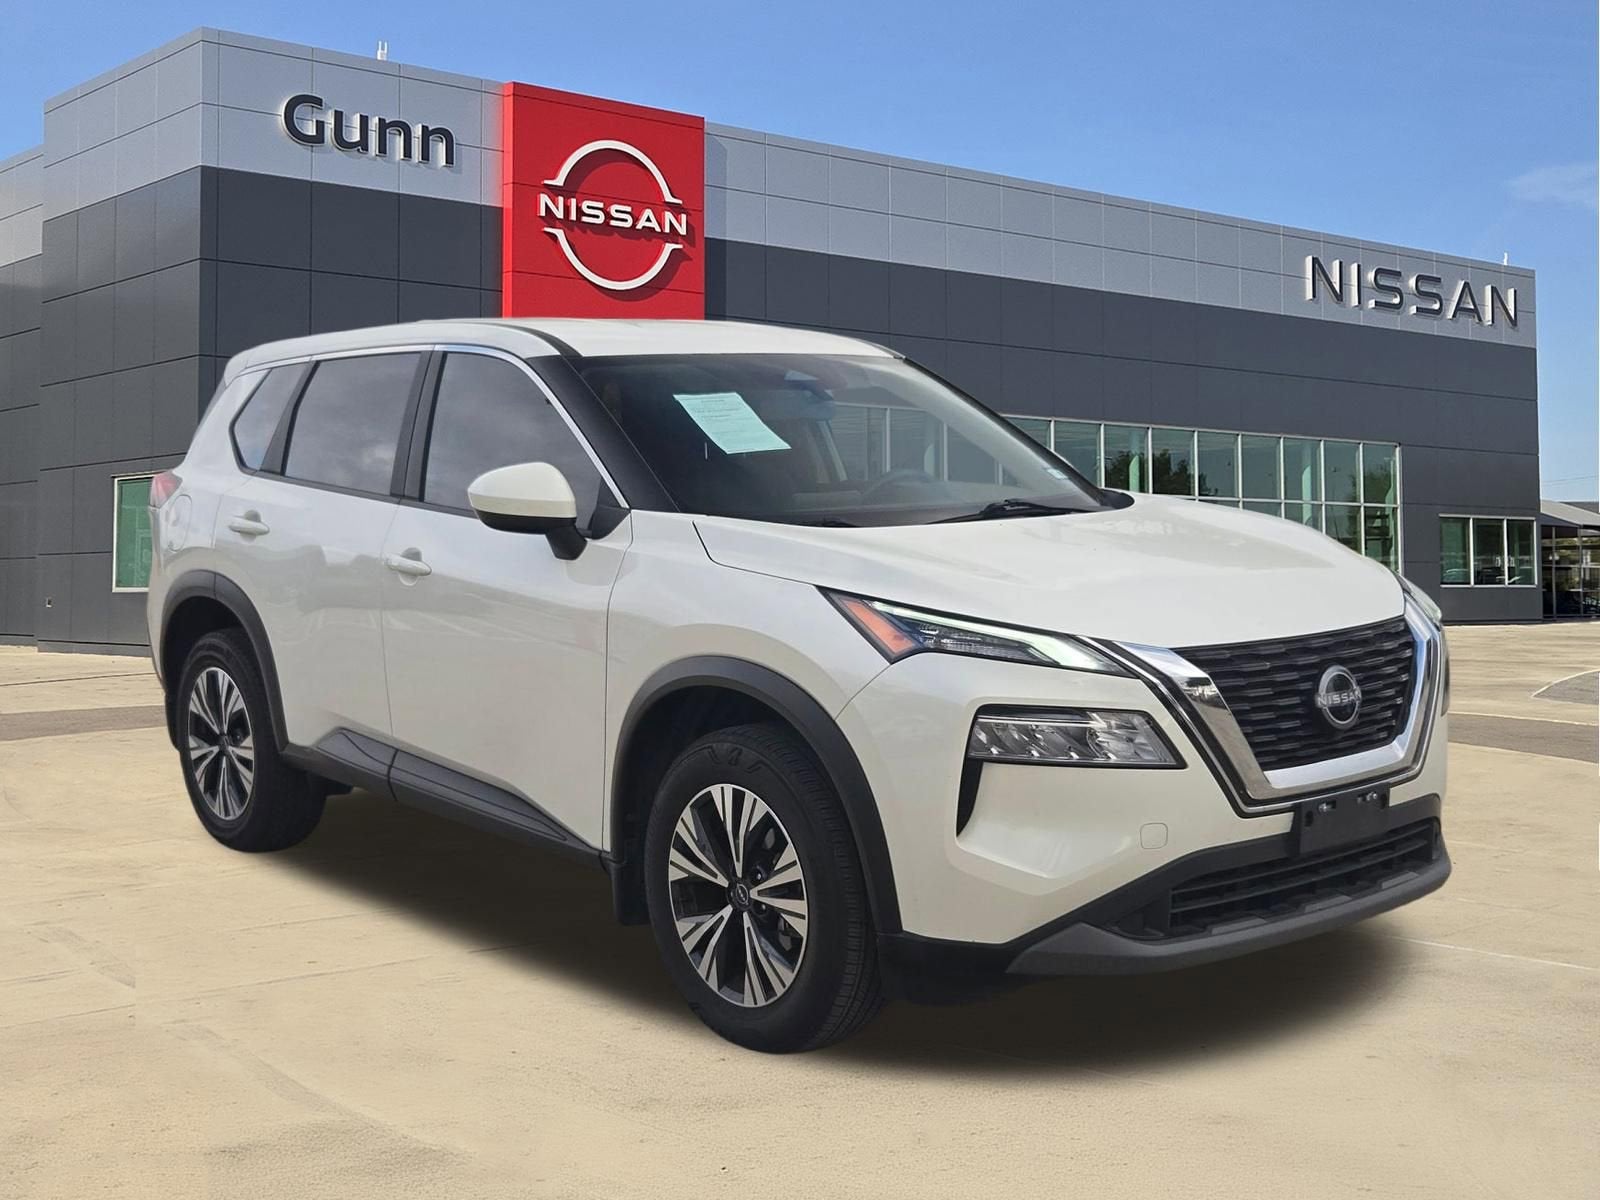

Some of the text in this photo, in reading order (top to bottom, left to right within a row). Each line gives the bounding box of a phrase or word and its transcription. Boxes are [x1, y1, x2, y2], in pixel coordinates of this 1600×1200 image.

[282, 93, 455, 167] Gunn
[537, 193, 687, 236] NISSAN
[1305, 255, 1518, 327] NISSAN
